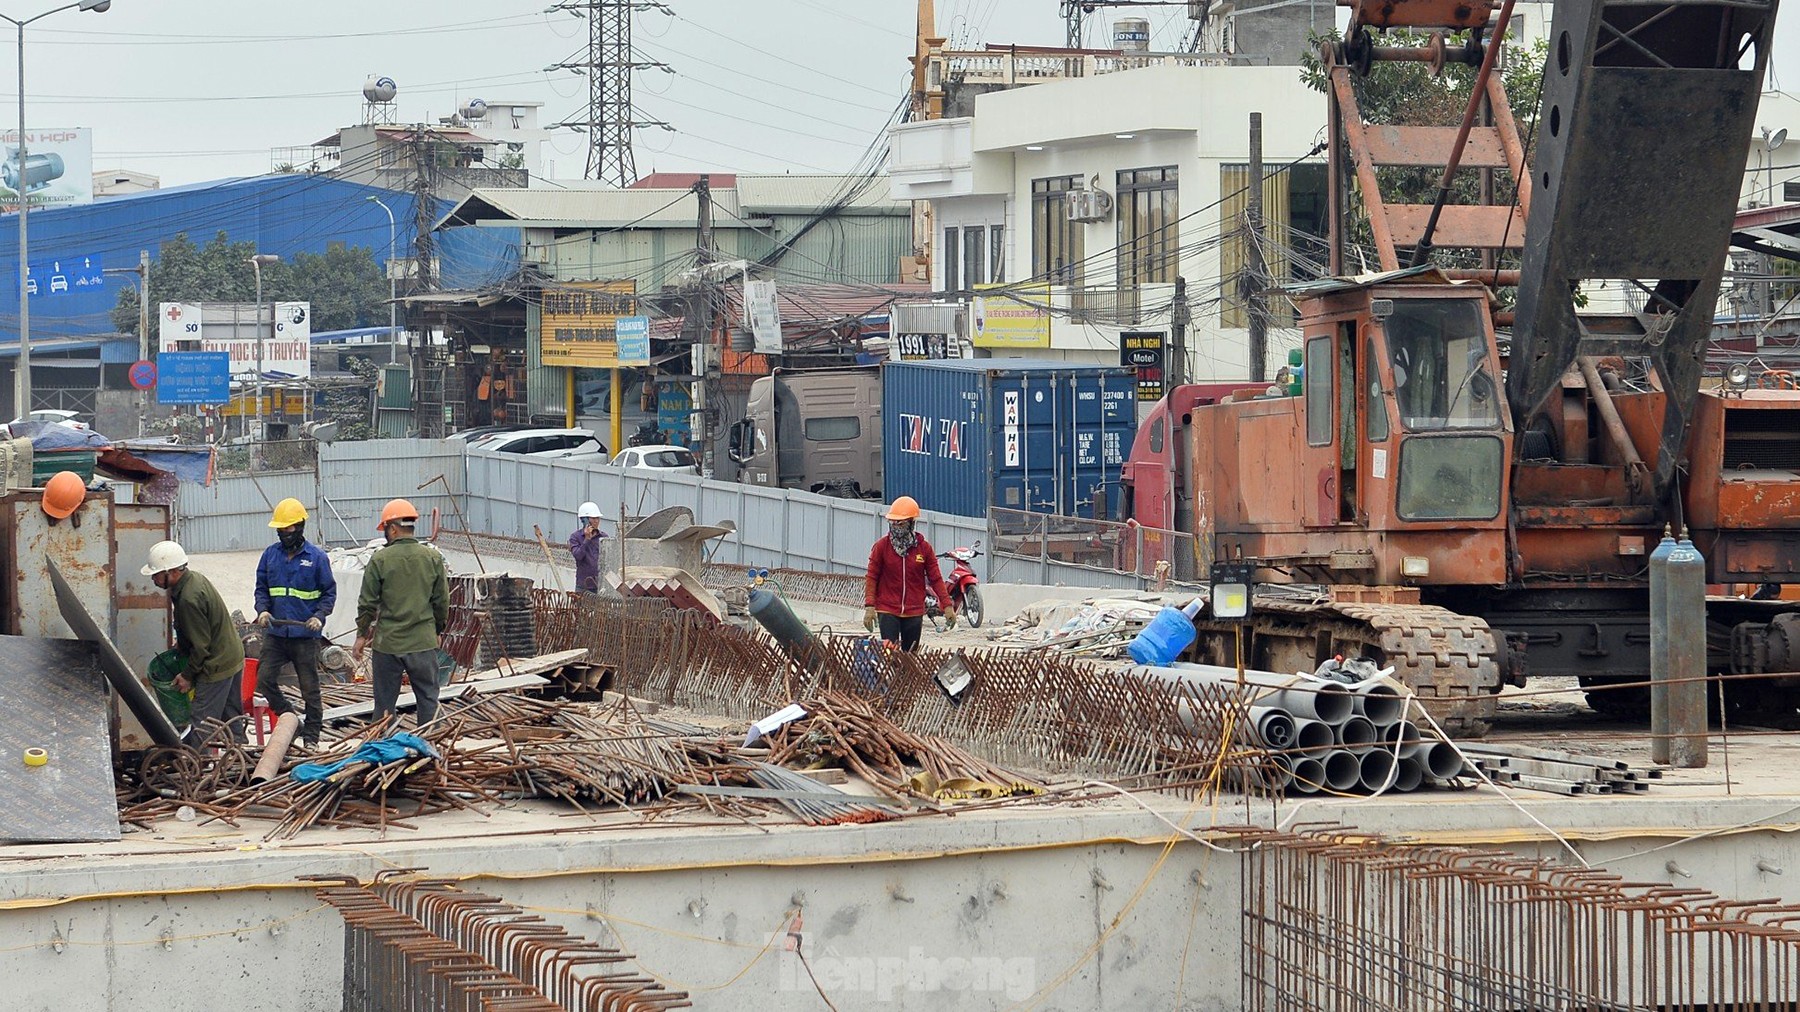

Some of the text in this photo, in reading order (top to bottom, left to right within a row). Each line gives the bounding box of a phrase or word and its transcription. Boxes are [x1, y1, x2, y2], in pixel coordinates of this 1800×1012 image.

[230, 343, 250, 365] HỌC
[270, 337, 308, 361] TRUYỀN
[900, 333, 926, 355] 1991
[1133, 353, 1155, 363] Motel
[1005, 396, 1017, 462] WAN HAI
